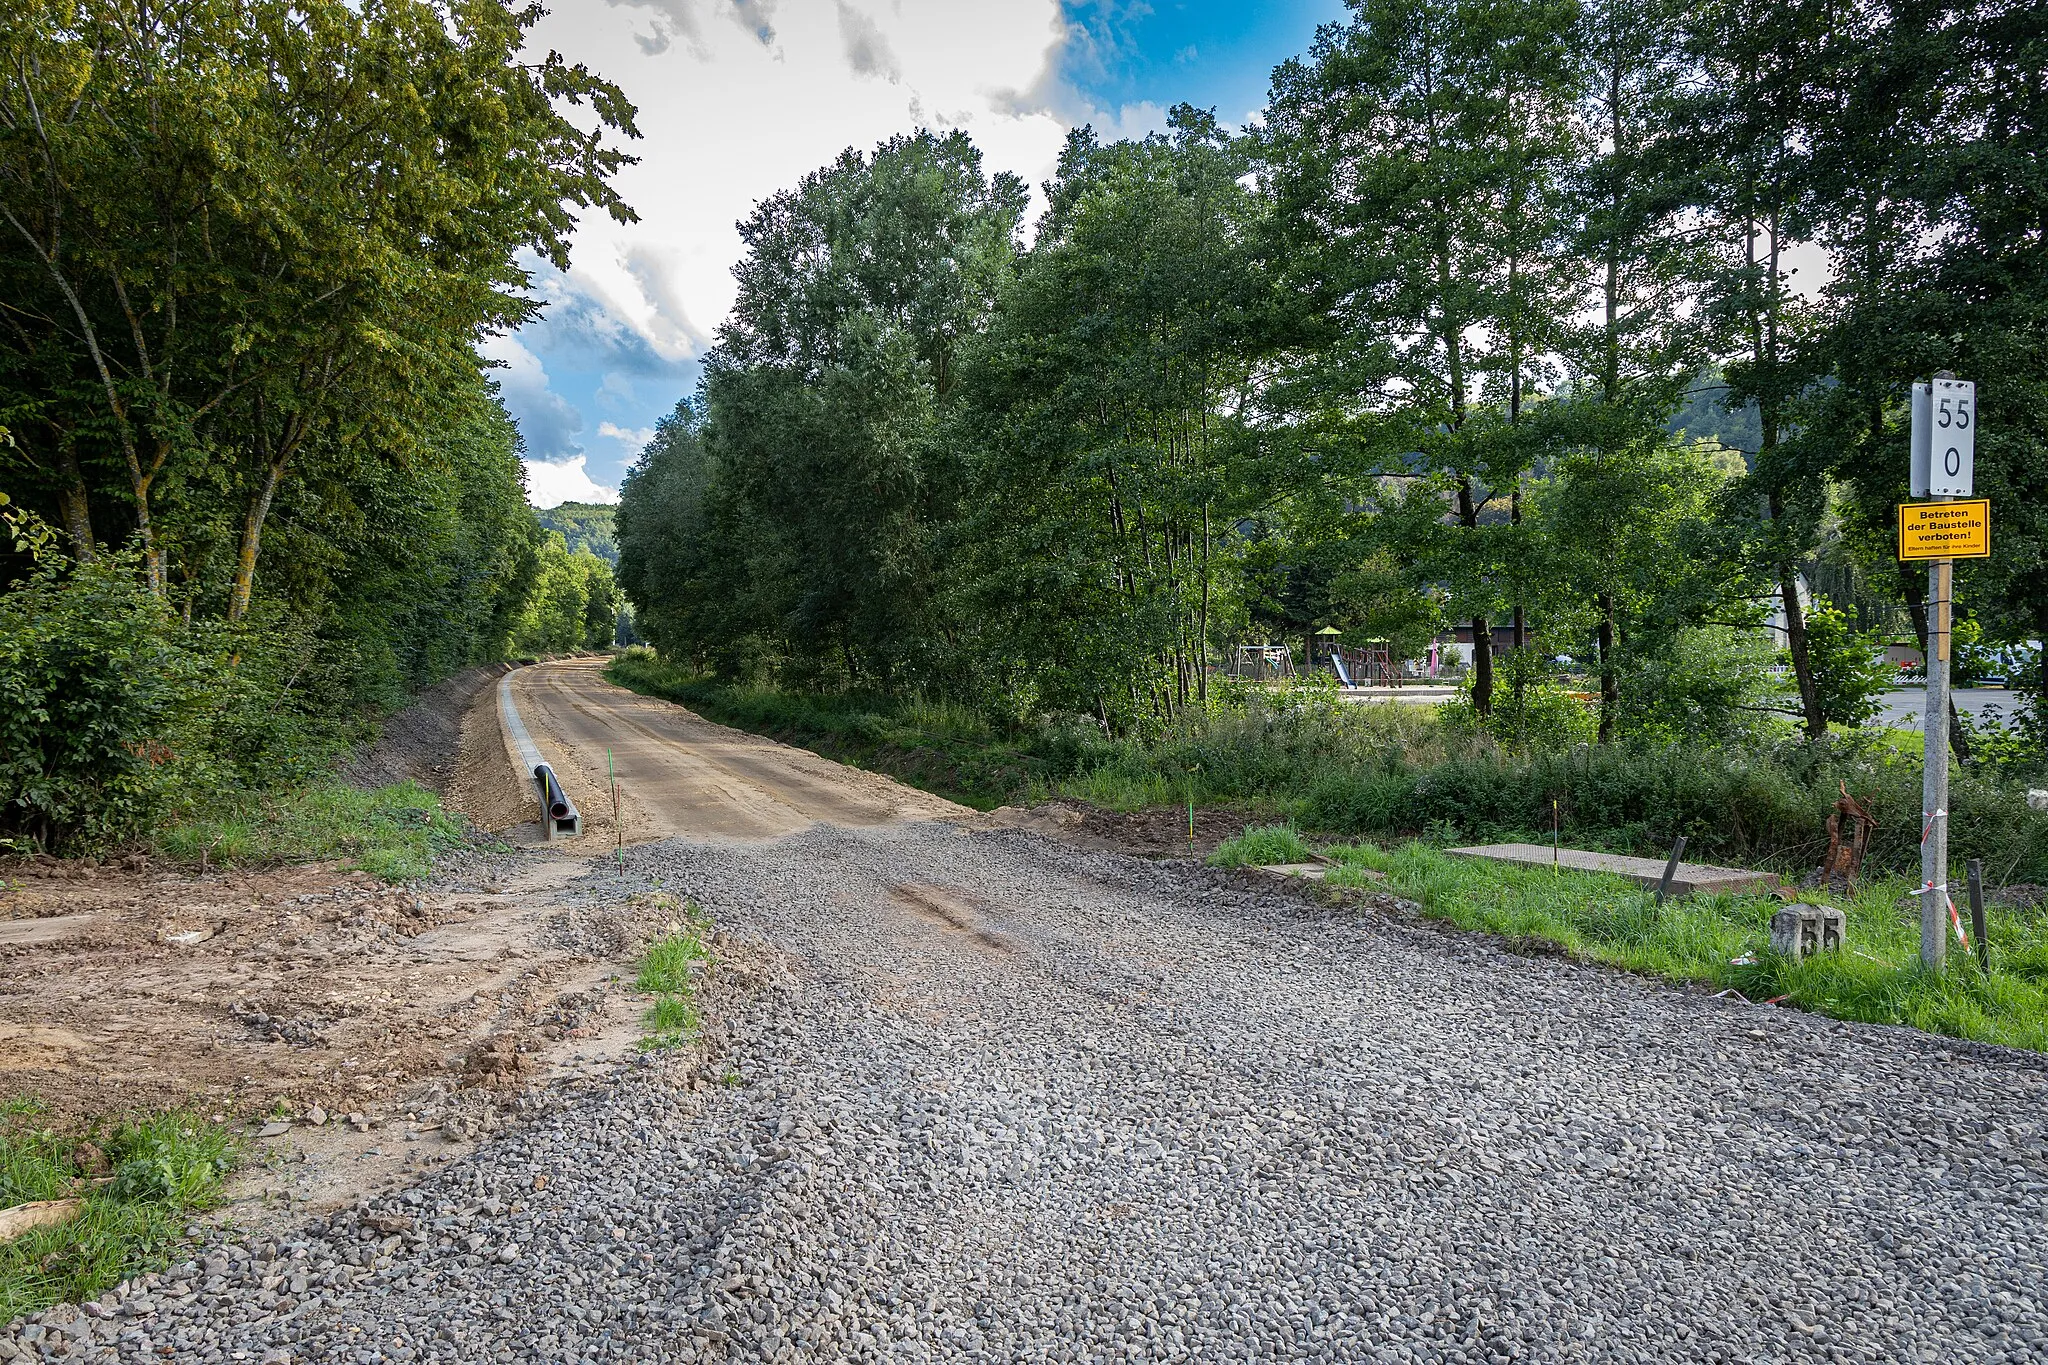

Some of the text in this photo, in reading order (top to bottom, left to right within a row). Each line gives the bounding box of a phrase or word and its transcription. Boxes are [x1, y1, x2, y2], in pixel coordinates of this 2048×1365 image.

[1938, 398, 1969, 429] 55
[1944, 447, 1960, 477] 0
[1920, 510, 1968, 519] Betreten
[1907, 520, 1982, 531] der Baustelle
[1918, 531, 1971, 541] verboten!
[1801, 918, 1840, 957] 55
